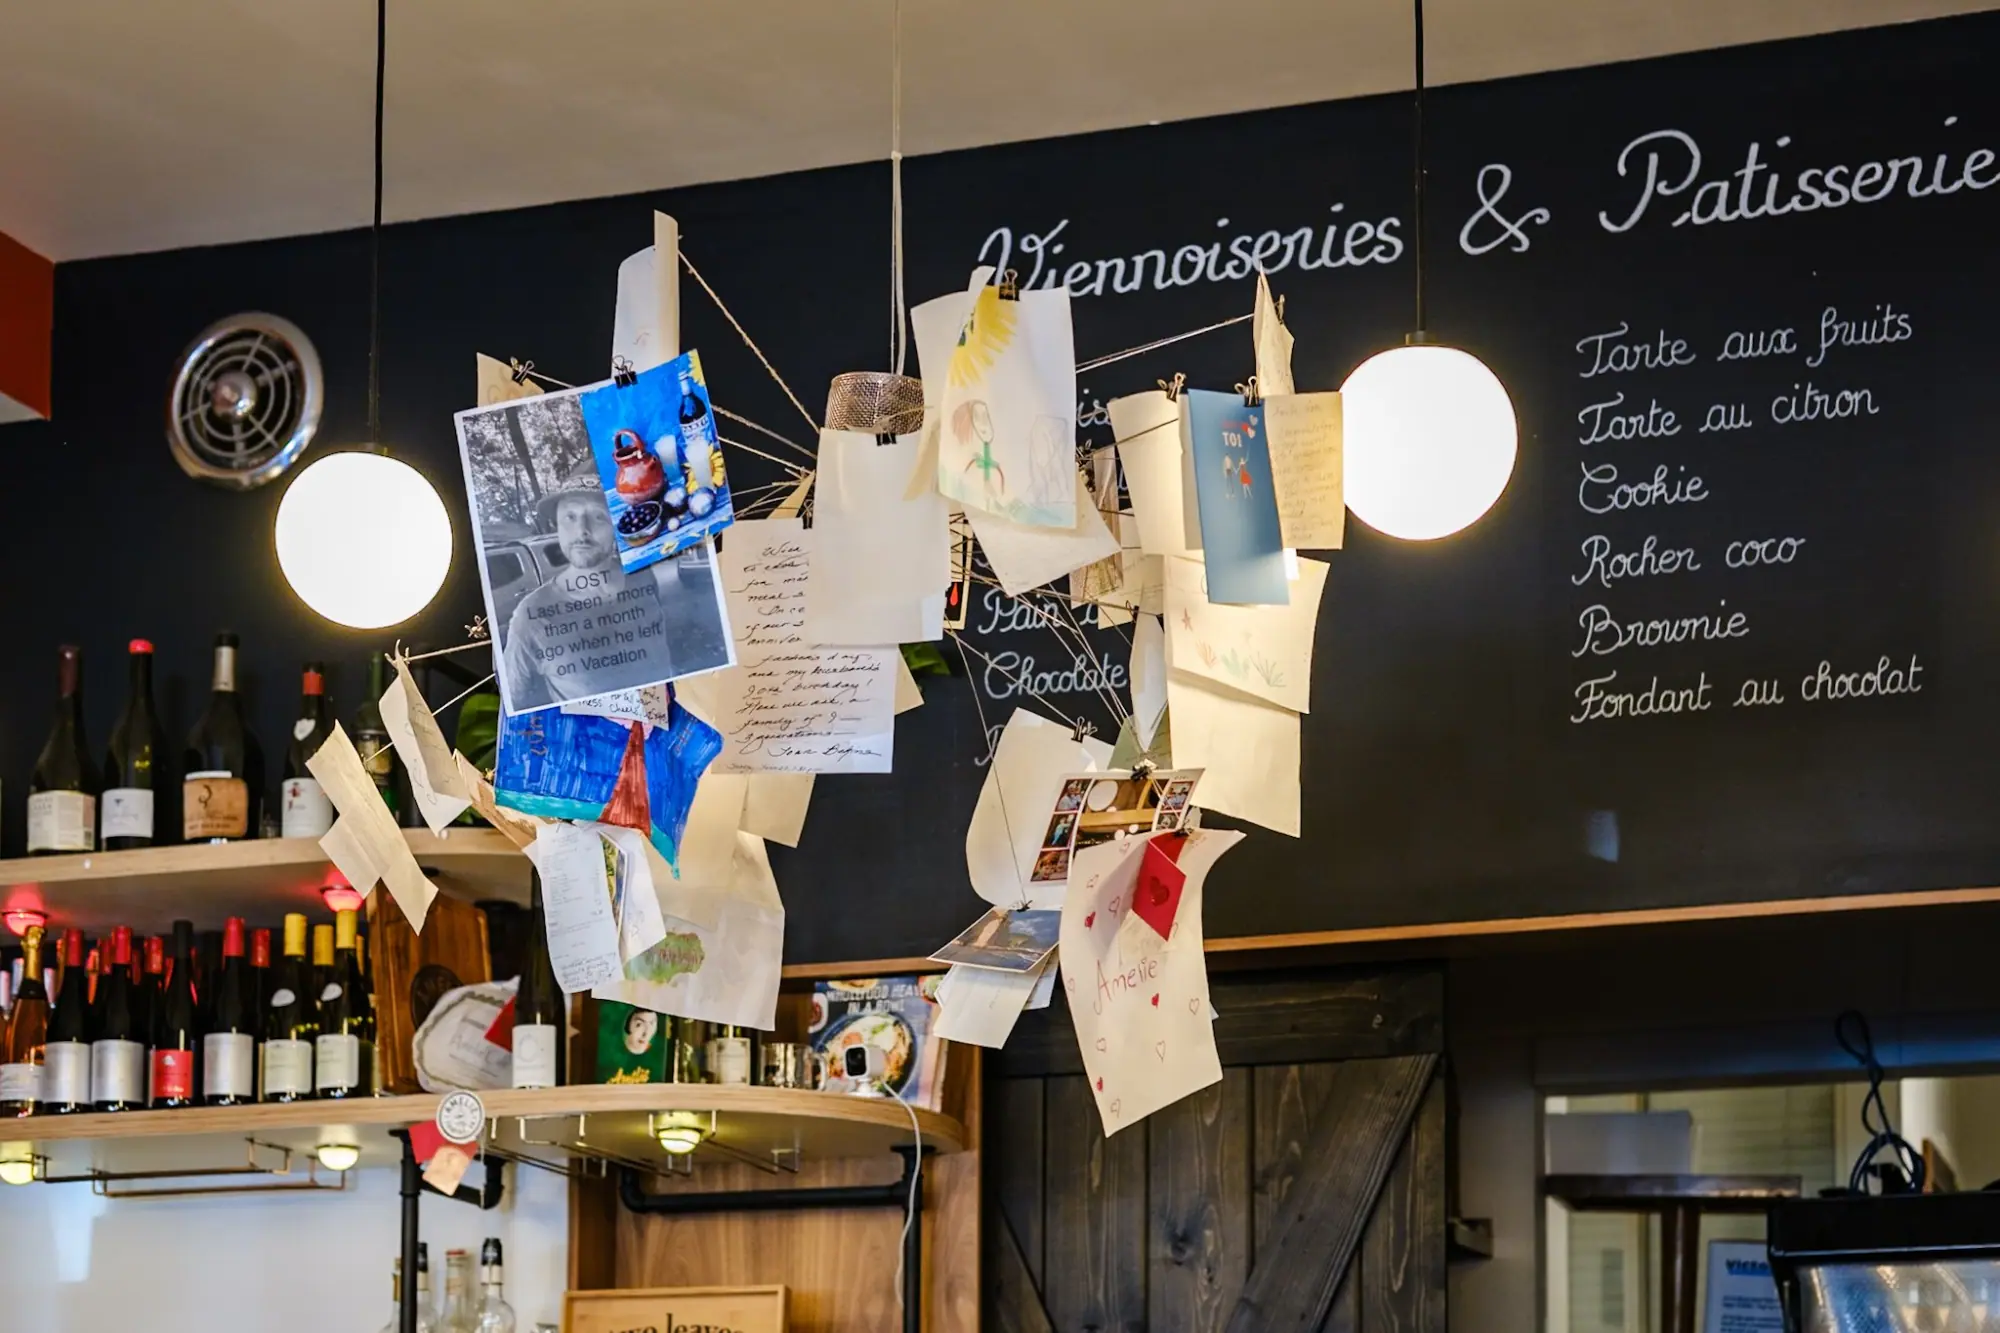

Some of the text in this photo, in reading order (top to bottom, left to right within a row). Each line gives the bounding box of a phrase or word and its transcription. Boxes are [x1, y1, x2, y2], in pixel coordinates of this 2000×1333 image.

[978, 203, 1404, 298] Viennoiseries
[1459, 164, 1550, 255] &
[1576, 303, 1912, 378] Tarte aux fruits
[1578, 383, 1880, 445] Tarte au citron
[1578, 461, 1709, 514] Cookie
[565, 570, 610, 592] LOST
[1572, 534, 1806, 588] Rocher coco
[527, 604, 561, 620] Last
[566, 597, 601, 613] seen
[617, 585, 655, 602] more
[544, 606, 645, 638] than a month
[978, 588, 1065, 634] Pain
[535, 621, 662, 662] ago when he left
[1572, 599, 1749, 657] Brownie
[557, 648, 647, 676] on Vacation
[984, 651, 1128, 699] Chocolate
[1570, 654, 1924, 724] Fondant au chocolat
